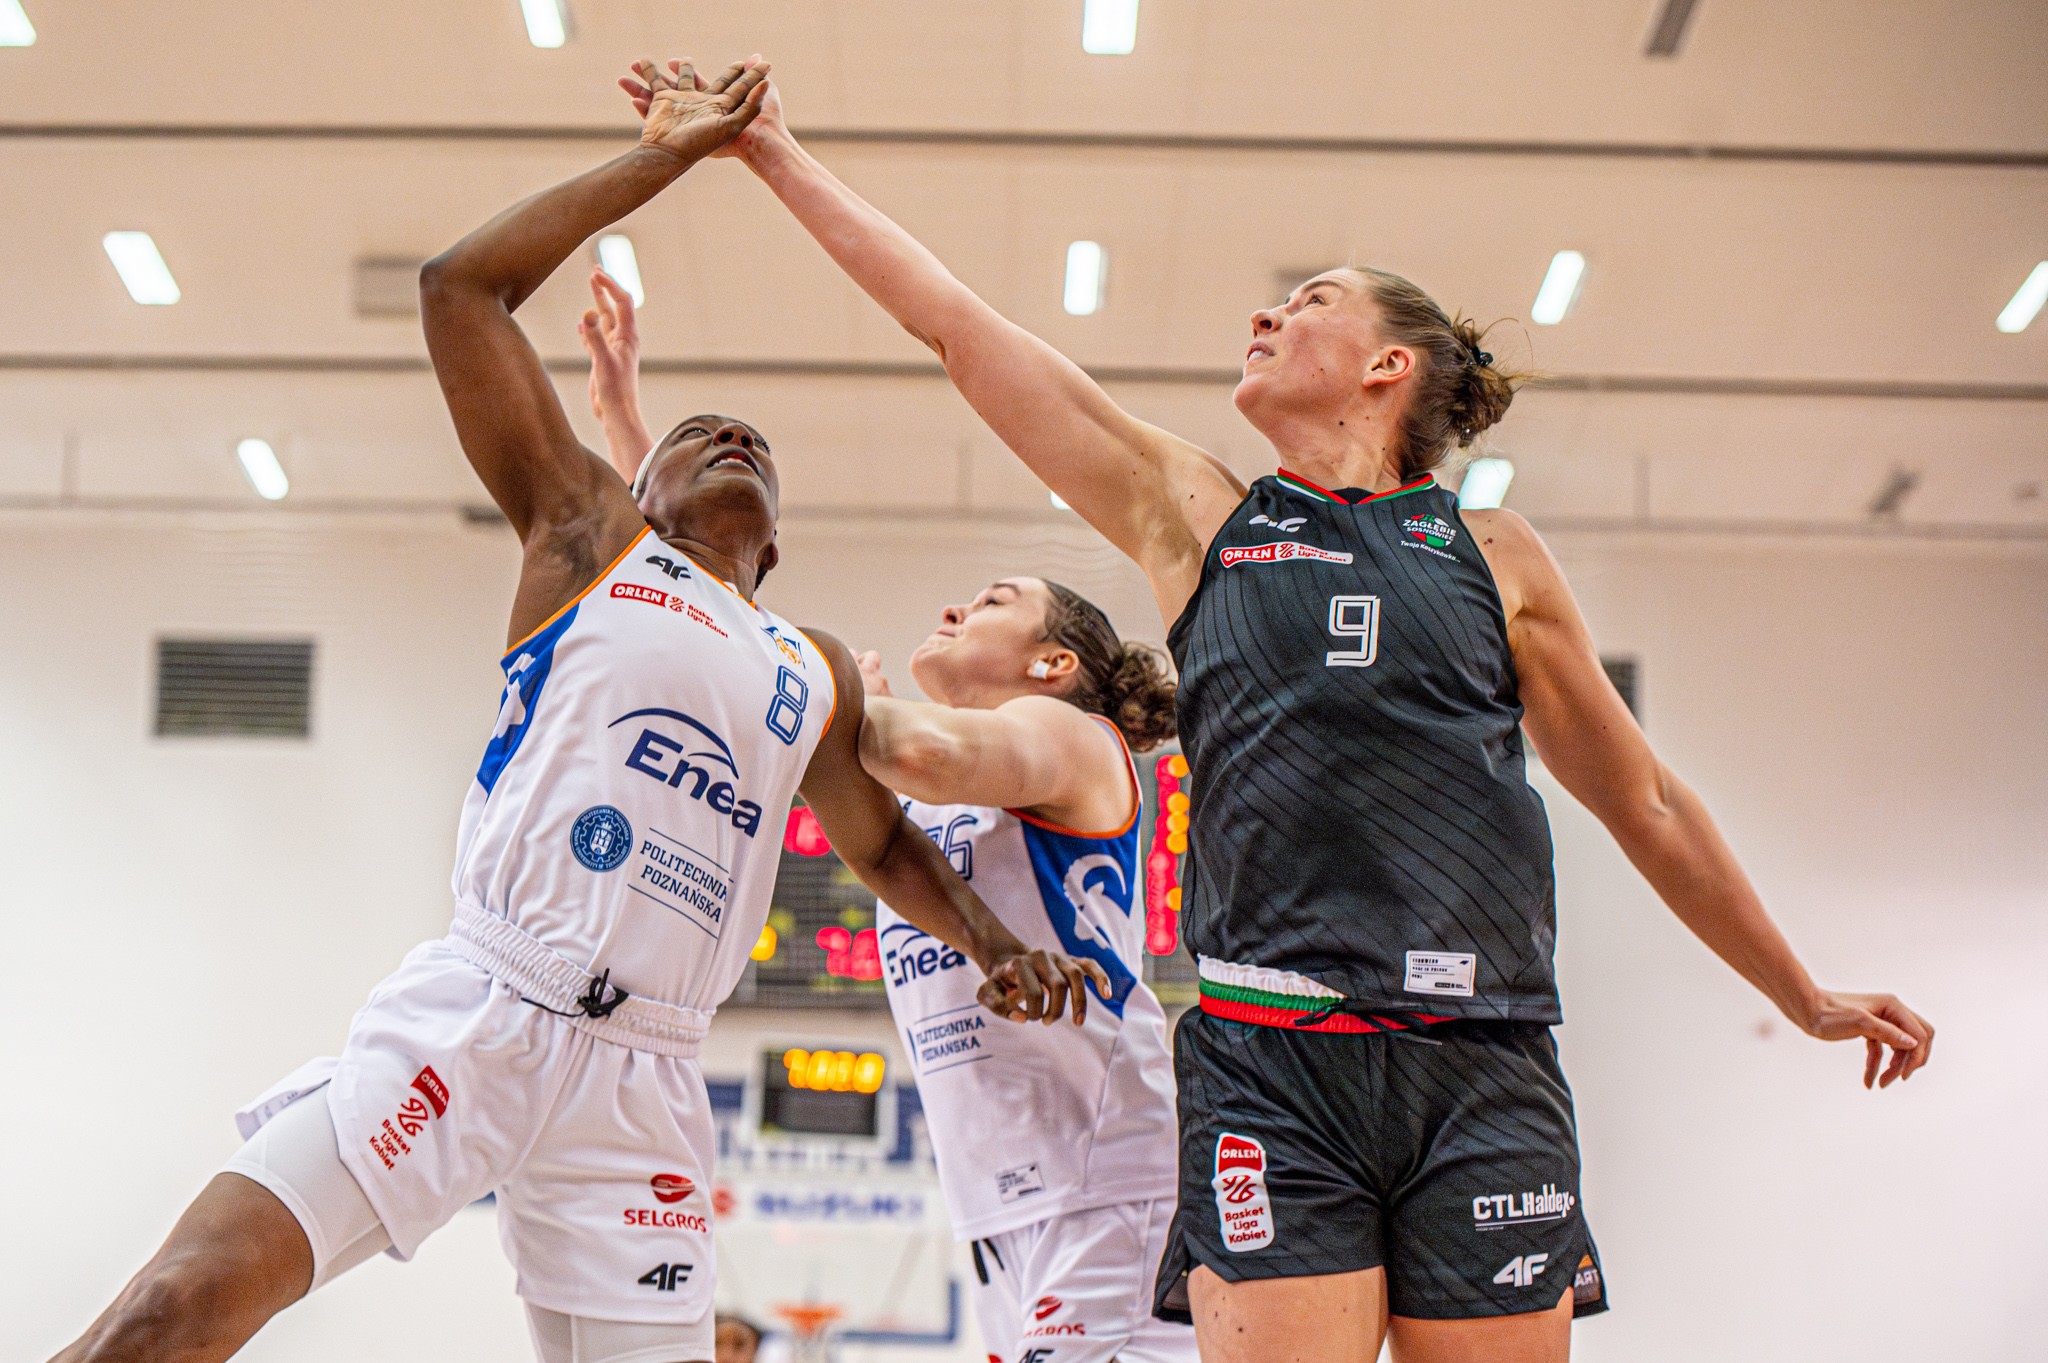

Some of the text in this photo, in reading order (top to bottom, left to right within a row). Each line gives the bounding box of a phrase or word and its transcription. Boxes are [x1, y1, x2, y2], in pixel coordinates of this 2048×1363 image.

[1407, 527, 1455, 541] SOSNOWIEC
[1224, 548, 1271, 561] ORLEN
[614, 585, 662, 603] ORLEN
[1326, 595, 1380, 667] 9
[766, 665, 808, 745] 8
[625, 728, 762, 838] Enea
[641, 865, 721, 922] POZNAŃSKA
[421, 1074, 447, 1106] ORLEN
[381, 1133, 398, 1156] Liga
[382, 1119, 411, 1155] Basket
[369, 1136, 395, 1170] Kobiet
[1221, 1149, 1259, 1159] ORLEN
[624, 1209, 706, 1233] SELGROS
[1225, 1207, 1264, 1221] Basket
[1233, 1220, 1258, 1231] Liga
[1228, 1230, 1267, 1244] Kobiet
[638, 1263, 693, 1291] 4F
[1493, 1253, 1549, 1287] 4F
